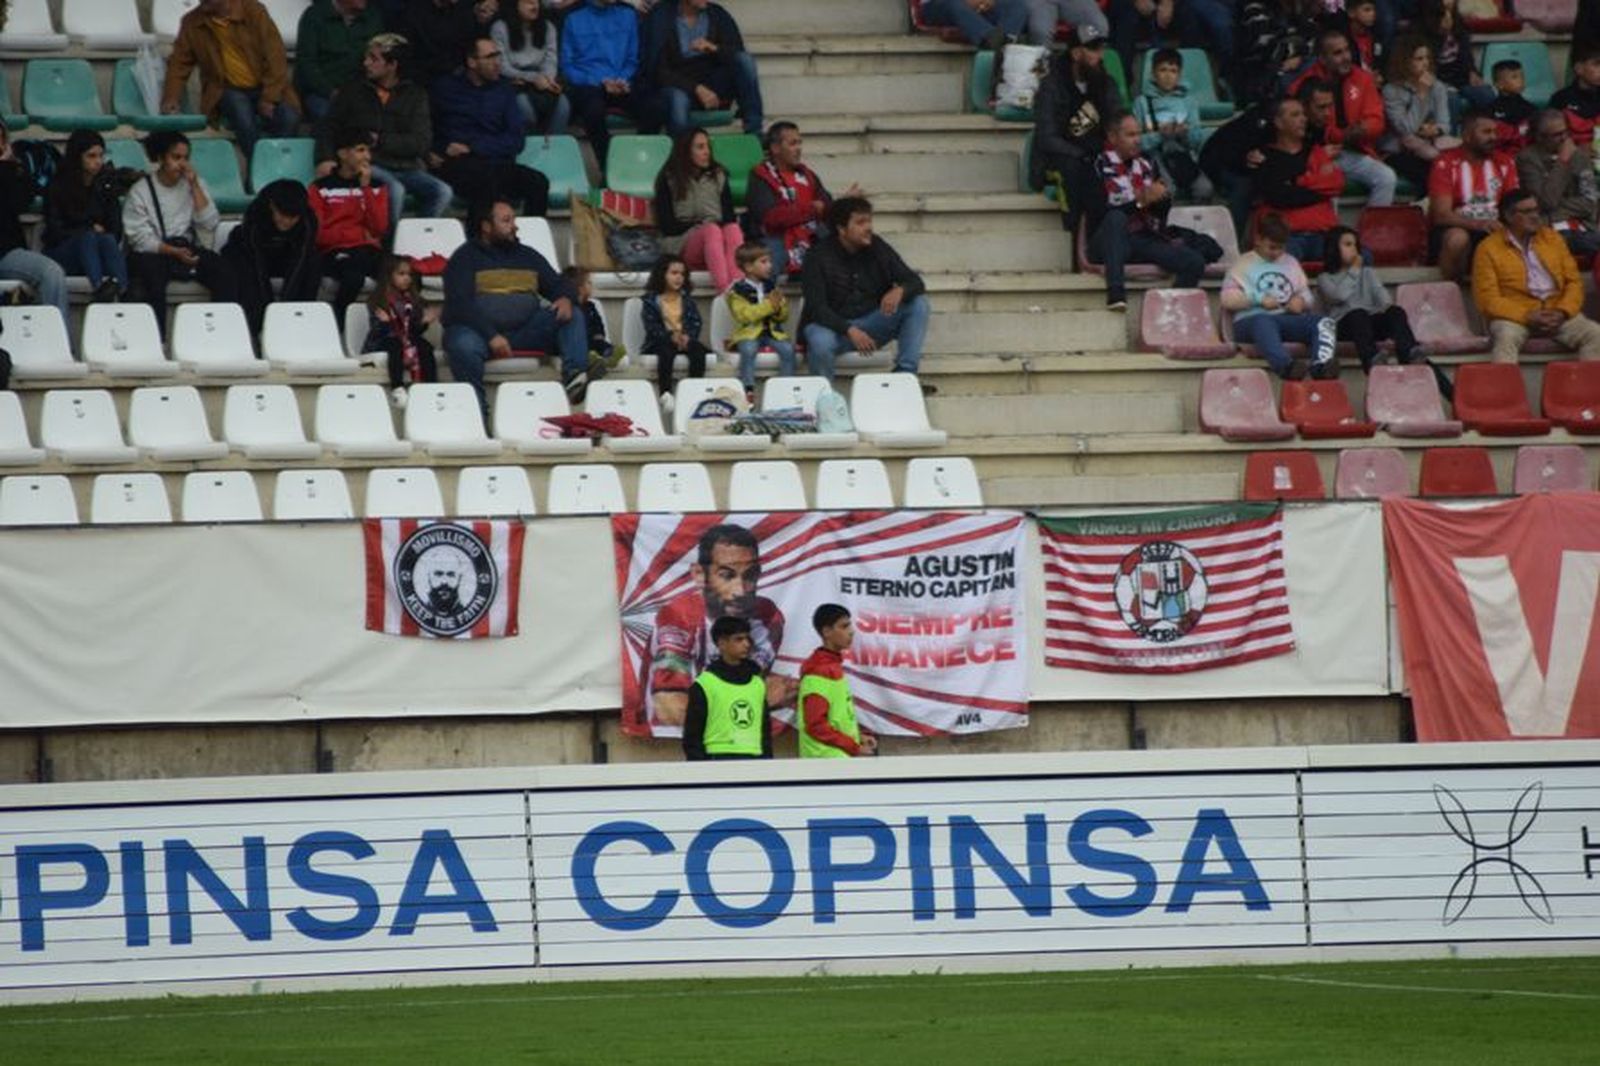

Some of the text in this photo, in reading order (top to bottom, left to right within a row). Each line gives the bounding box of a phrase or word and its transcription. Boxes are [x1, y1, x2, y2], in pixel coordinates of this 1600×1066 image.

[1077, 521, 1137, 535] VAMOS
[412, 530, 481, 558] MOVILLISMO
[841, 576, 926, 598] ETERNO
[407, 594, 487, 628] KEEP THE FAITH
[856, 609, 1014, 635] SIEMPRE
[0, 808, 1271, 951] PINSA COPINSA
